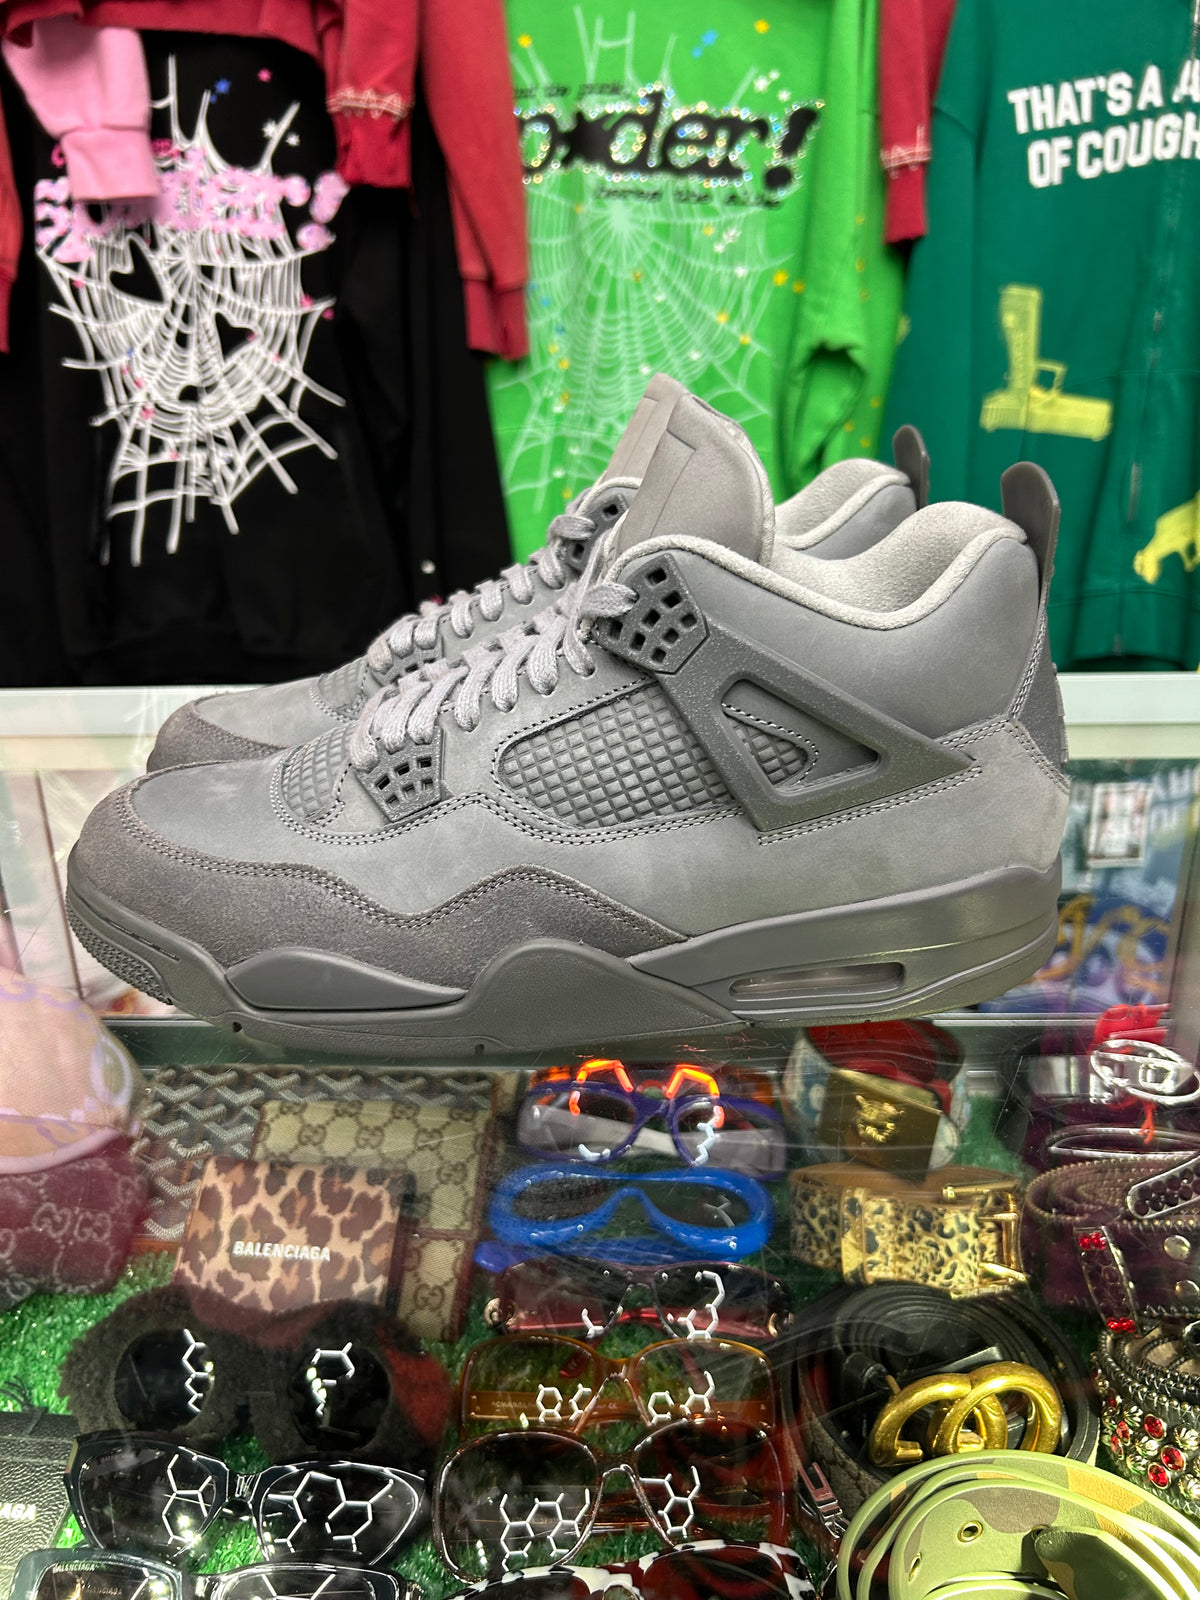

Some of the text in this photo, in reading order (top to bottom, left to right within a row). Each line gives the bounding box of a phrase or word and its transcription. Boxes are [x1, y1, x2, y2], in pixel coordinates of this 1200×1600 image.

[1007, 71, 1133, 135] THAT'S
[1137, 64, 1164, 111] A
[1028, 136, 1073, 189] OF
[232, 1240, 331, 1262] BALENCIAGA
